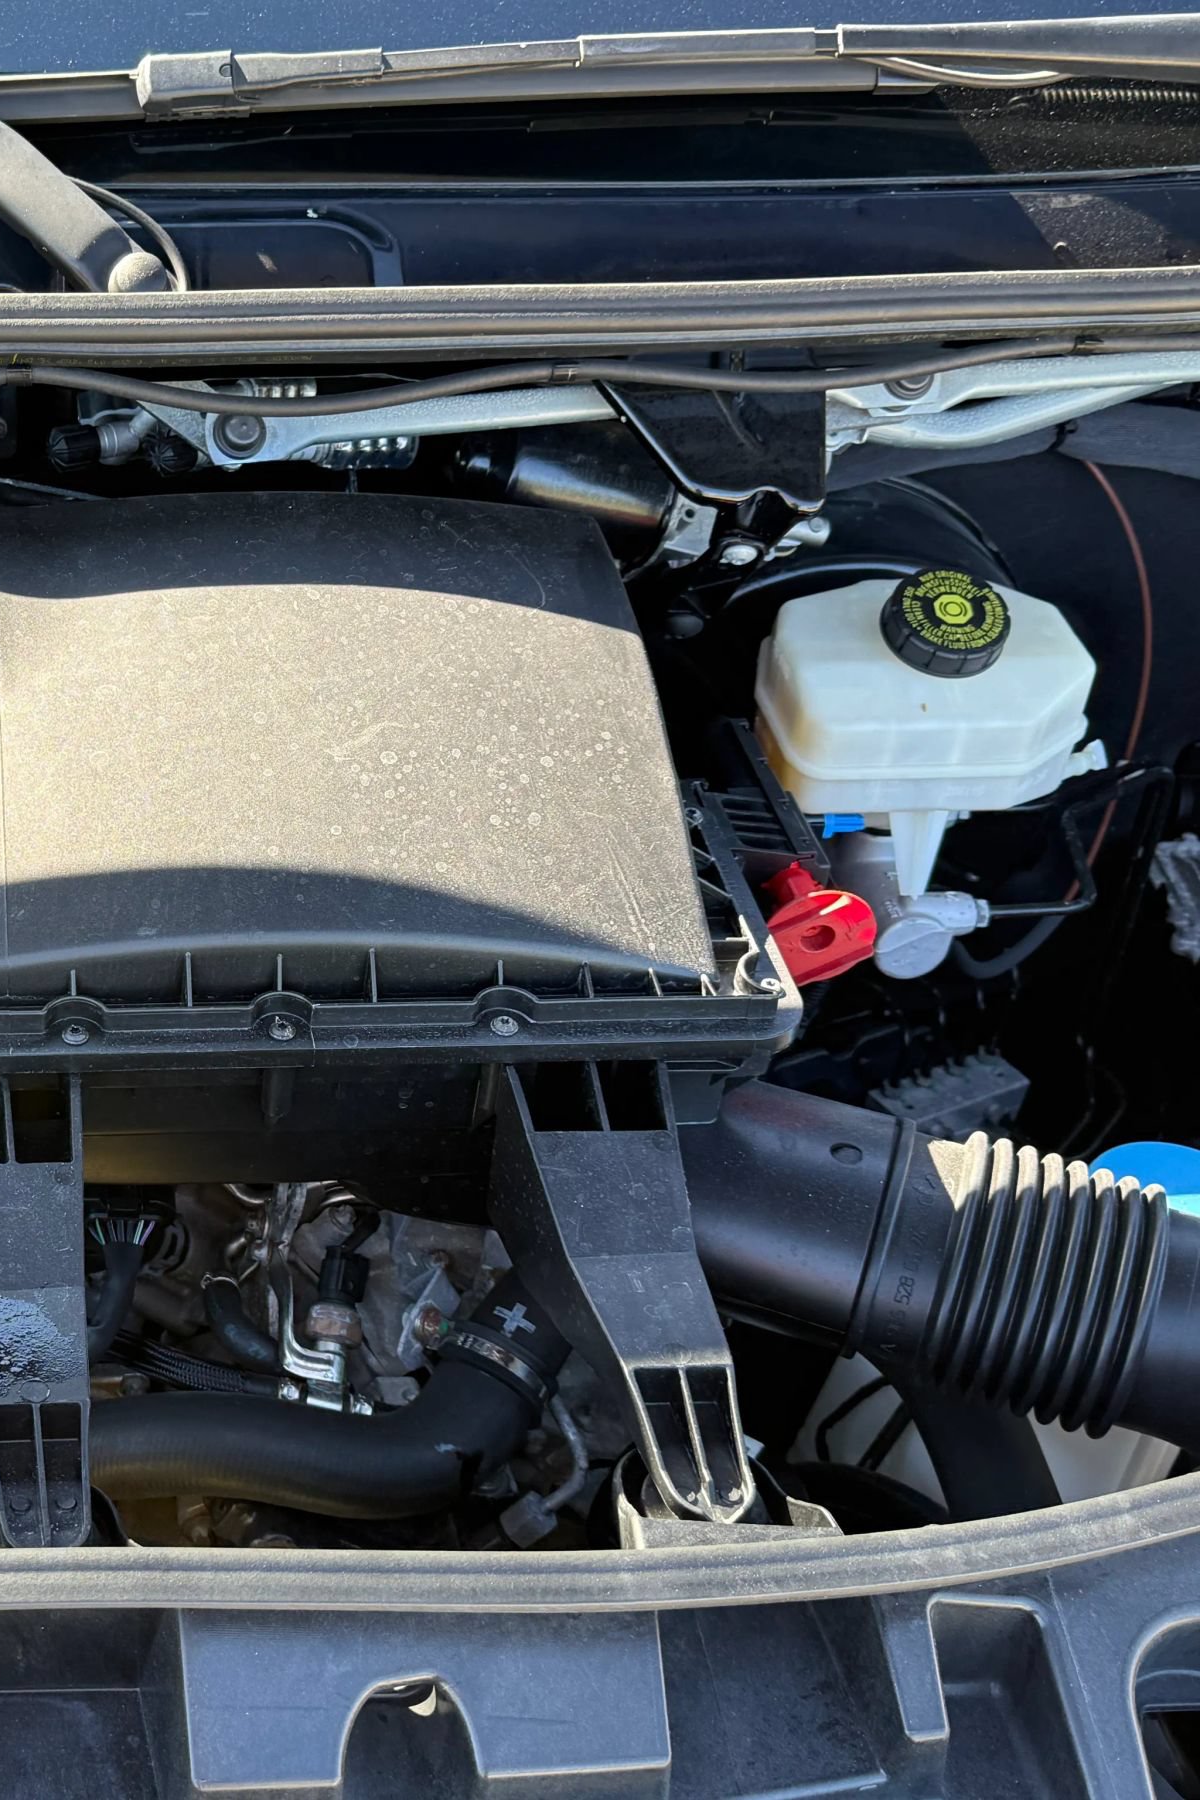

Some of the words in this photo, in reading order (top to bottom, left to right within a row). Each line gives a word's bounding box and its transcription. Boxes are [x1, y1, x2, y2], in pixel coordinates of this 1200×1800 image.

[935, 570, 973, 584] ORIGINAL
[919, 629, 943, 646] BRAKE
[944, 640, 966, 649] FLUID
[894, 1275, 915, 1306] 528
